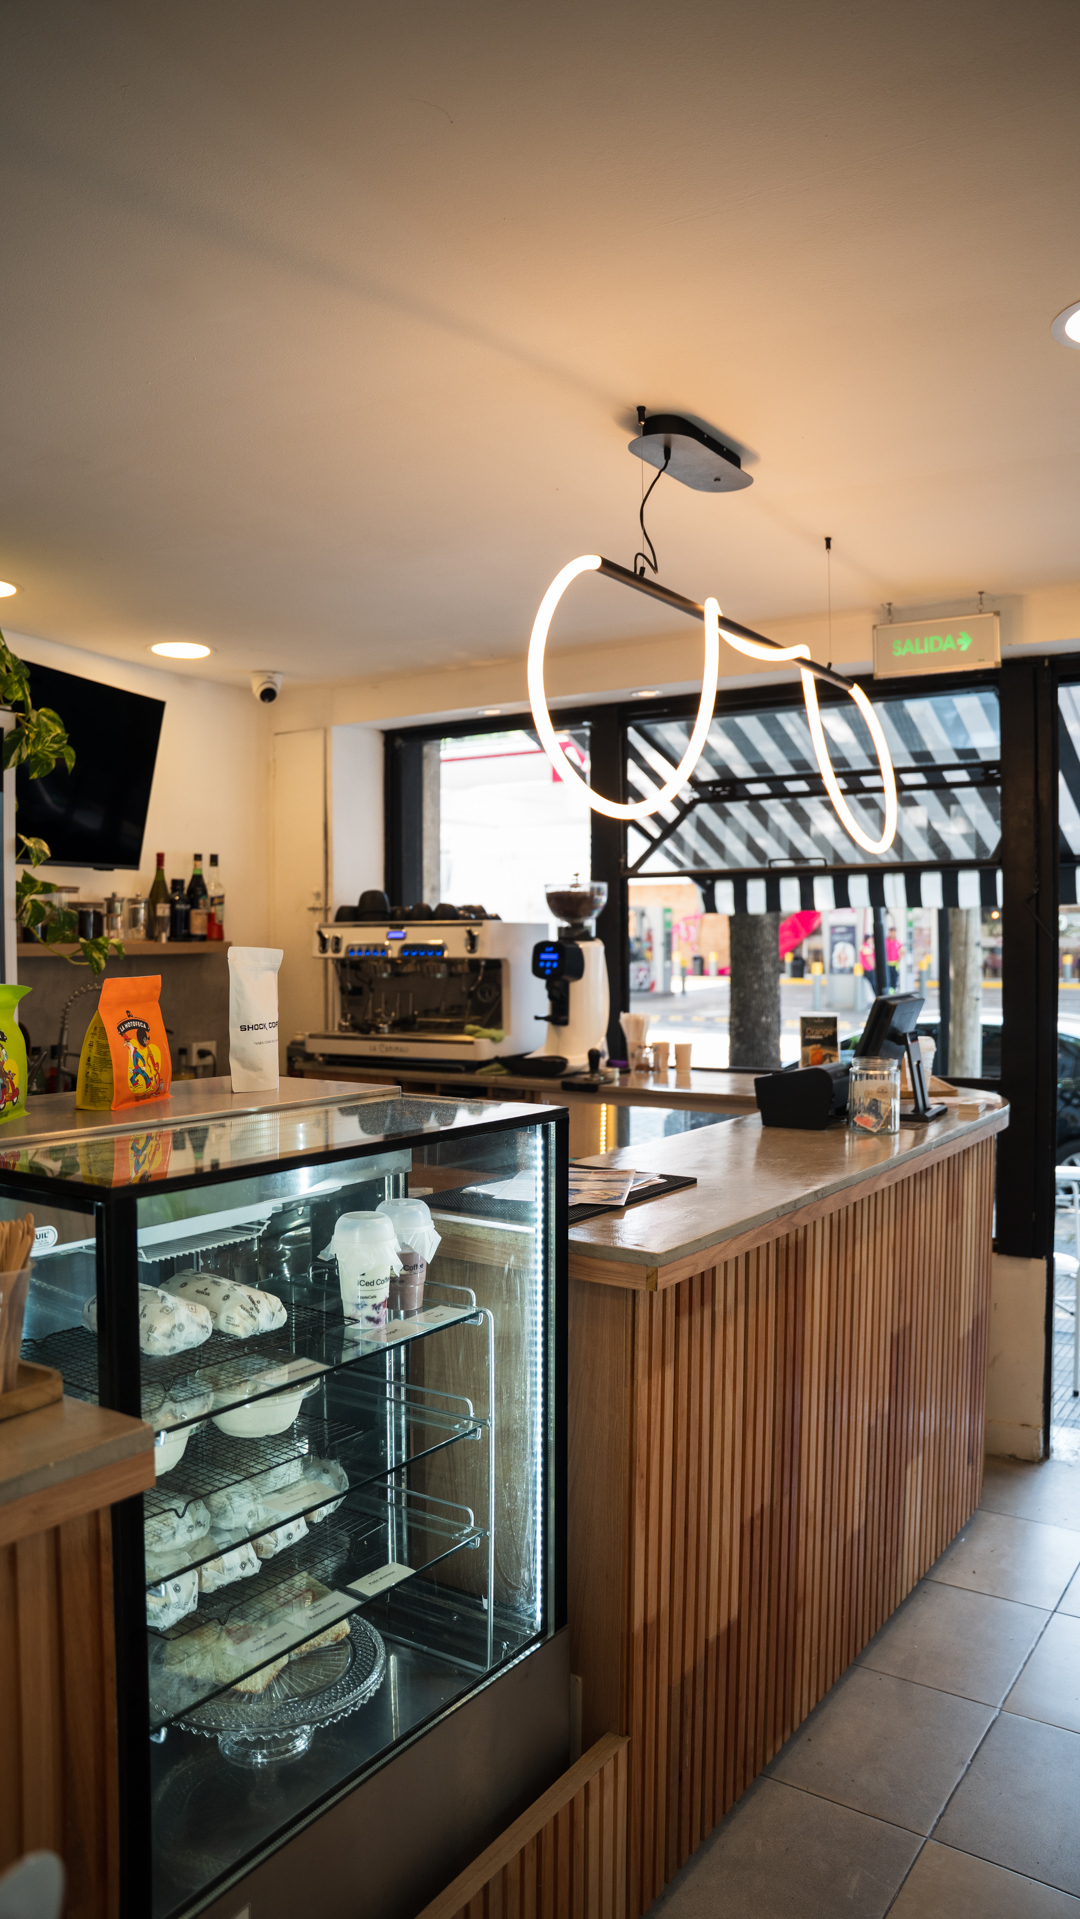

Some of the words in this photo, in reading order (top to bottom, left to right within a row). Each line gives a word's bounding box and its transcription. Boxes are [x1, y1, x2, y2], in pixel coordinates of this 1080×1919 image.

[892, 634, 957, 657] SALIDA
[239, 1023, 268, 1031] SHOCK
[805, 1027, 834, 1038] Orange
